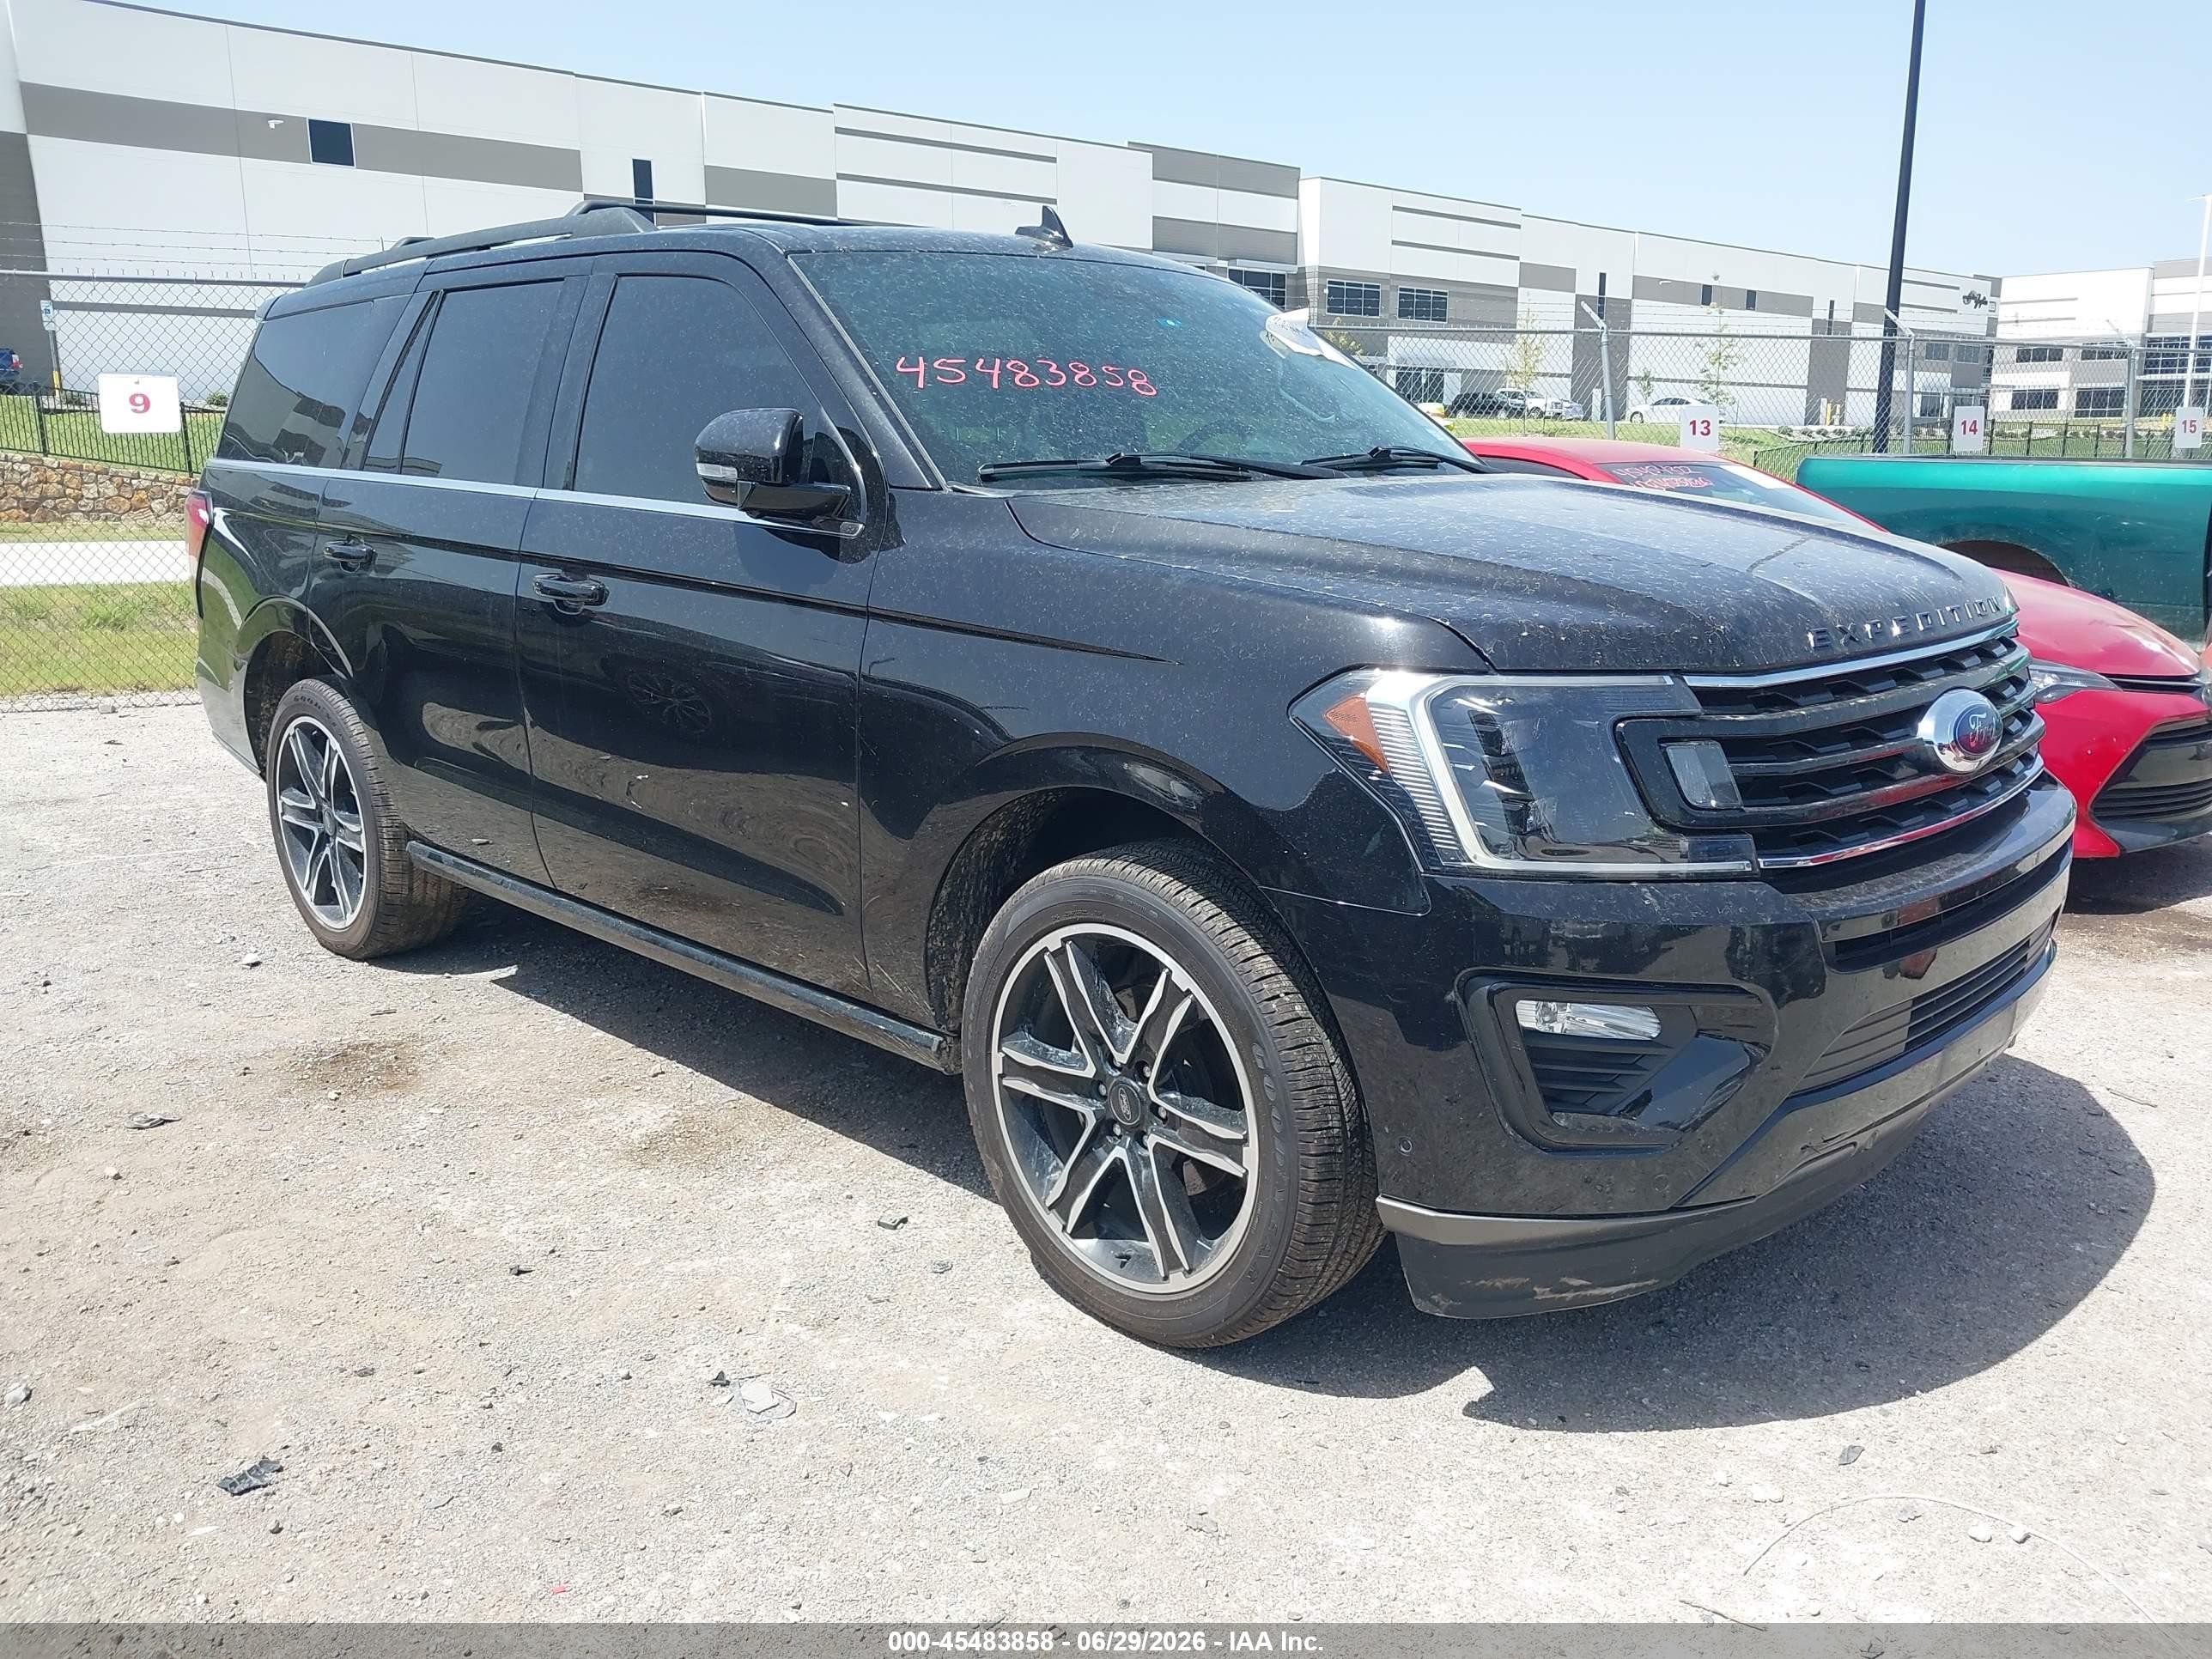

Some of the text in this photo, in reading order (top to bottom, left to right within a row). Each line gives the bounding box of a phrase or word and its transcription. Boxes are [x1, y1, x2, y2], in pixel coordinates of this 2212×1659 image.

[896, 356, 1158, 397] 45483858
[129, 392, 152, 414] 9
[1689, 419, 1711, 436] 13
[1960, 419, 1978, 435] 14
[2181, 419, 2197, 434] 15
[1807, 596, 2001, 648] EXPEDITION
[1969, 712, 1998, 749] Ford
